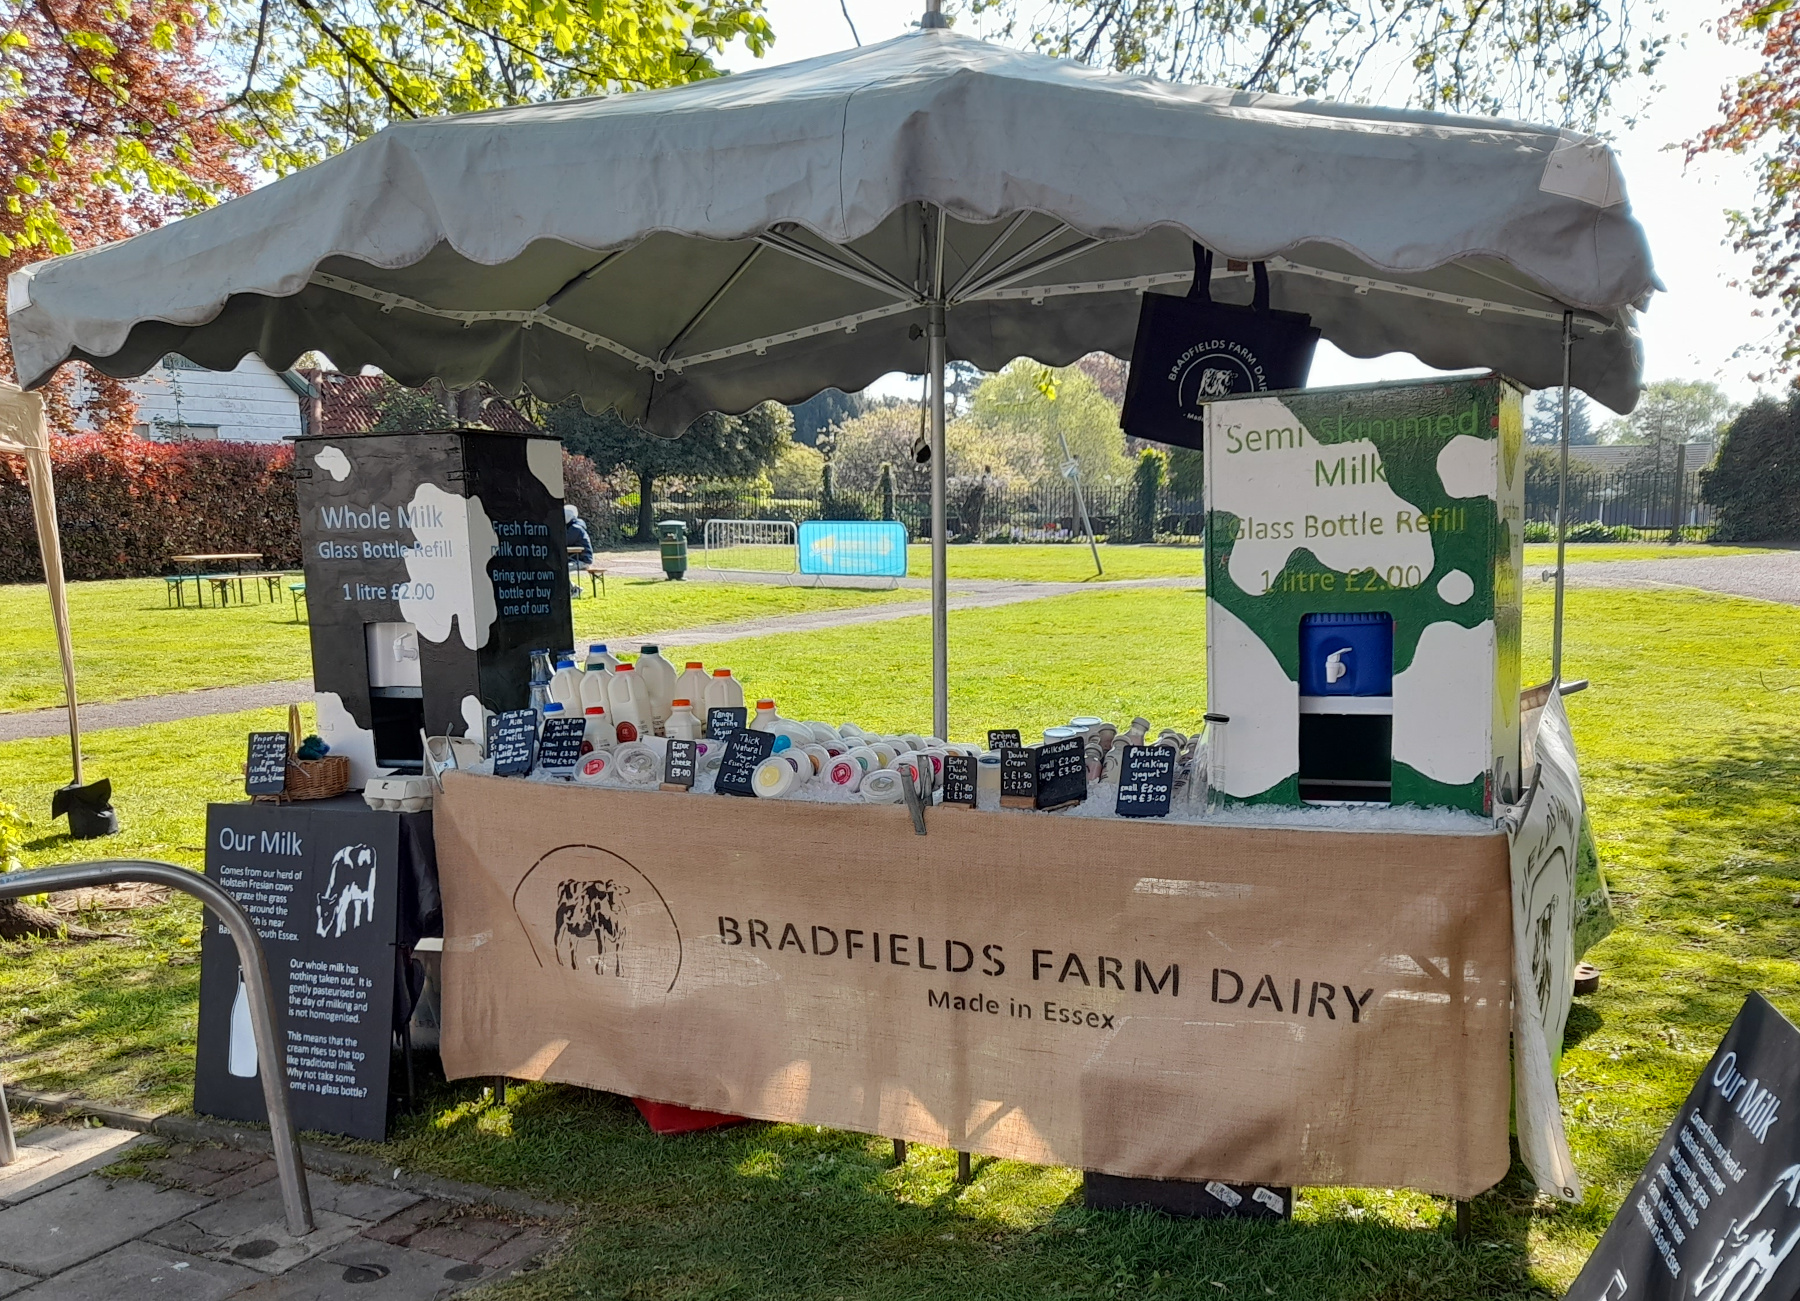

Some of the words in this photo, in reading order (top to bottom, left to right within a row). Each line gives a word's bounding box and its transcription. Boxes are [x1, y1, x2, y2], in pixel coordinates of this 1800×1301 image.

[1168, 340, 1226, 381] BRADFIELDS
[1229, 342, 1257, 365] FARM
[1254, 366, 1268, 392] DAIR
[1226, 424, 1303, 454] Semi
[1319, 402, 1478, 445] Skimmed
[1315, 454, 1388, 487] Milk
[321, 506, 391, 530] Whole
[398, 506, 443, 529] Milk
[1227, 517, 1294, 541] Glass
[1305, 511, 1383, 538] Bottle
[1397, 507, 1464, 533] Refill
[492, 520, 521, 536] Fresh
[524, 521, 548, 536] farm
[319, 542, 361, 559] Glass
[363, 541, 409, 559] Bottle
[414, 540, 453, 558] Refill
[491, 541, 513, 556] milk
[516, 545, 529, 556] on
[531, 544, 548, 560] tap
[493, 569, 515, 584] Bring
[516, 571, 535, 583] your
[537, 571, 554, 580] own
[1261, 570, 1274, 593] 1
[1283, 570, 1336, 592] litre
[1345, 566, 1422, 593] £2.00
[343, 584, 351, 601] 1
[356, 583, 386, 600] litre
[392, 583, 435, 600] £2.00
[499, 587, 524, 599] bottle
[526, 589, 535, 598] or
[536, 586, 551, 600] buy
[504, 606, 519, 615] one
[521, 601, 530, 614] of
[532, 604, 549, 613] ours
[712, 719, 738, 728] Pouring
[713, 710, 734, 722] Tangy
[740, 734, 761, 745] Thick
[673, 751, 686, 759] Herb
[733, 743, 762, 755] Natural
[1008, 751, 1029, 759] Double
[1130, 747, 1170, 758] Probiotic
[949, 758, 968, 766] Extra
[1040, 760, 1055, 770] small
[1131, 759, 1169, 773] drinking
[949, 773, 968, 781] Cream
[1131, 770, 1161, 782] yogurt
[1121, 783, 1138, 792] small
[220, 828, 256, 852] Our
[261, 831, 303, 856] Milk
[220, 865, 244, 876] Comes
[245, 867, 261, 876] from
[277, 869, 293, 880] herd
[295, 871, 303, 880] of
[220, 878, 248, 888] Holstein
[249, 880, 274, 890] Fresian
[275, 883, 294, 892] cows
[236, 892, 254, 901] graze
[256, 892, 267, 902] the
[269, 895, 287, 904] grass
[250, 905, 275, 915] around
[276, 907, 288, 916] the
[262, 917, 267, 926] is
[269, 919, 285, 927] near
[290, 959, 304, 968] Our
[305, 960, 328, 971] whole
[329, 963, 345, 973] milk
[346, 964, 359, 974] has
[718, 916, 1005, 977] BRADFIELDS
[1032, 949, 1180, 997] FARM
[1212, 969, 1374, 1023] DAIRY
[290, 971, 317, 984] nothing
[319, 974, 339, 984] taken
[359, 977, 365, 987] It
[366, 978, 372, 987] is
[289, 984, 311, 996] gently
[313, 987, 355, 998] pasteurised
[356, 991, 366, 999] on
[289, 995, 301, 1004] the
[302, 996, 315, 1008] day
[317, 997, 325, 1007] of
[326, 999, 352, 1012] milking
[354, 1003, 368, 1012] and
[927, 988, 1000, 1017] Made
[1009, 997, 1032, 1020] in
[1043, 1001, 1115, 1030] Essex
[289, 1007, 294, 1016] is
[296, 1009, 308, 1017] not
[309, 1009, 361, 1023] homogenised.
[287, 1031, 302, 1041] This
[303, 1034, 327, 1044] means
[329, 1036, 344, 1045] that
[345, 1037, 358, 1047] the
[287, 1045, 309, 1054] cream
[311, 1046, 327, 1056] rises
[329, 1048, 336, 1057] to
[338, 1049, 350, 1059] the
[352, 1051, 365, 1062] top
[287, 1055, 299, 1065] like
[301, 1057, 337, 1069] traditional
[338, 1062, 356, 1072] milk.
[287, 1067, 303, 1079] Why
[304, 1071, 317, 1079] not
[318, 1071, 334, 1081] take
[335, 1075, 355, 1084] some
[290, 1081, 306, 1090] ome
[308, 1082, 314, 1091] in
[321, 1084, 339, 1095] glass
[341, 1086, 367, 1098] bottle?
[1713, 1051, 1747, 1103] Our
[1736, 1078, 1781, 1145] Milk
[1733, 1169, 1747, 1183] of
